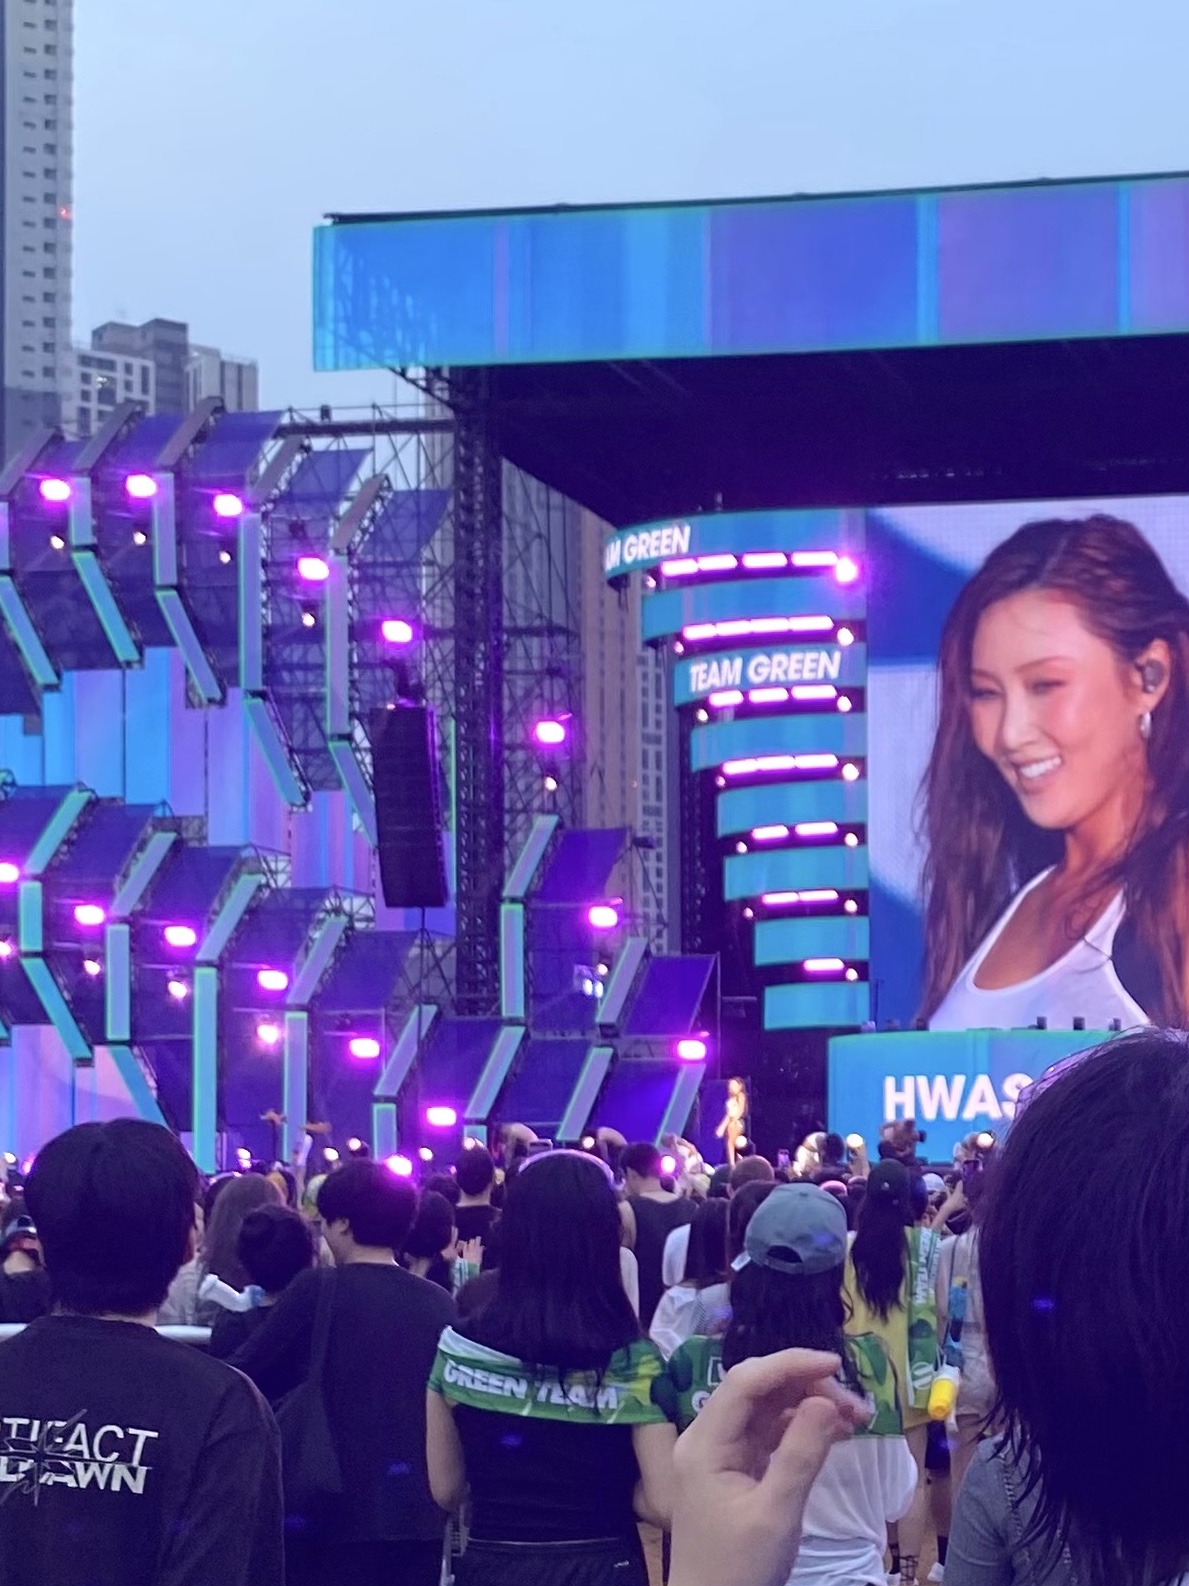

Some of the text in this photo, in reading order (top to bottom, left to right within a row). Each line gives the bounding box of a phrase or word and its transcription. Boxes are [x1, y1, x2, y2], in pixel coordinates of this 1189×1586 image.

[624, 525, 691, 564] GREEN
[690, 650, 842, 692] TEAM GREEN
[442, 1358, 619, 1410] GREEN TEAM
